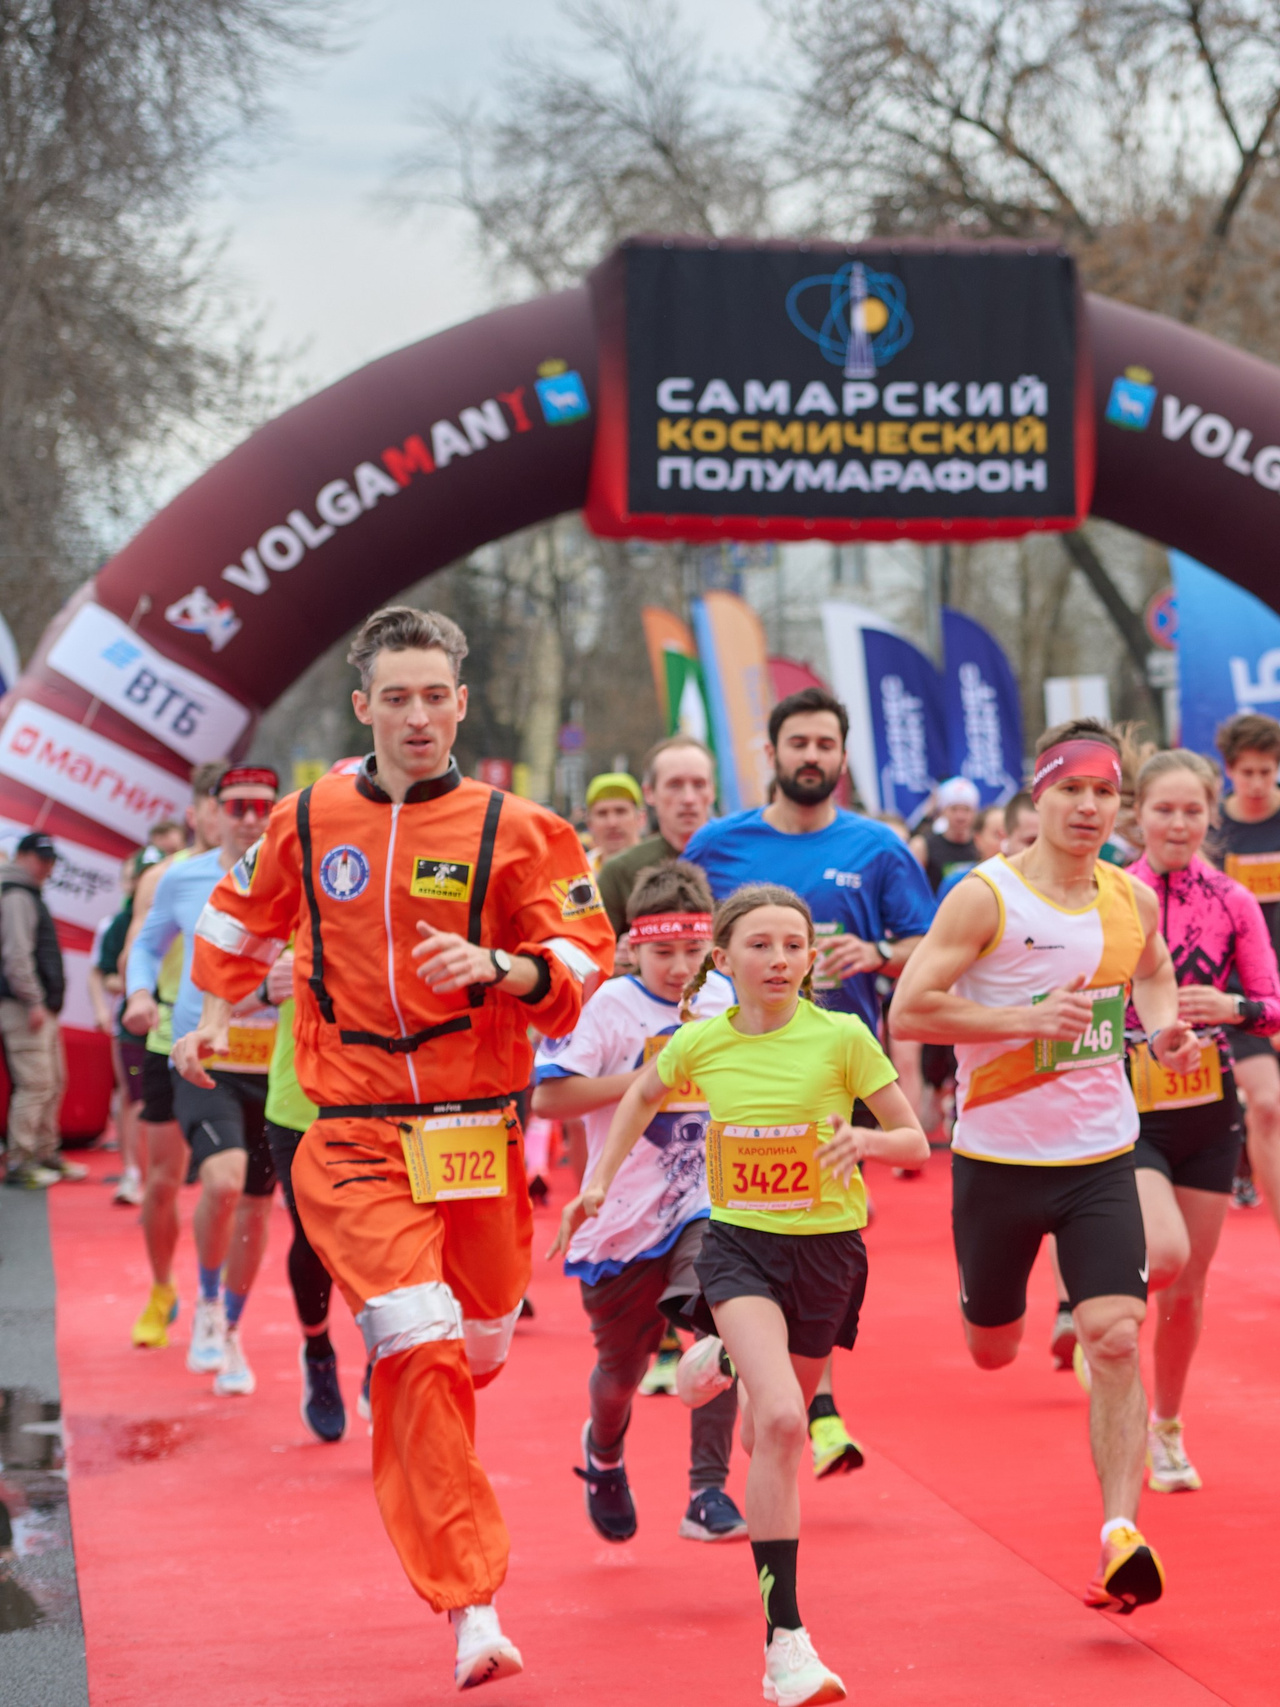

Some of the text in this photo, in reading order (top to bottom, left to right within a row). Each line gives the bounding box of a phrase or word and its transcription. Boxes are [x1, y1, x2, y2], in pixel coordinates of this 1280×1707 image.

[656, 374, 1048, 417] САМАРСКИЙ
[656, 417, 1048, 455] КОСМИЧЕСКИЙ
[656, 457, 1048, 494] ПОЛУМАРАФОН
[124, 667, 205, 738] ВТБ
[1032, 756, 1064, 785] ARMIN
[439, 1150, 497, 1183] 3722
[737, 1146, 798, 1157] КАРОЛИНА
[732, 1161, 809, 1195] 3422
